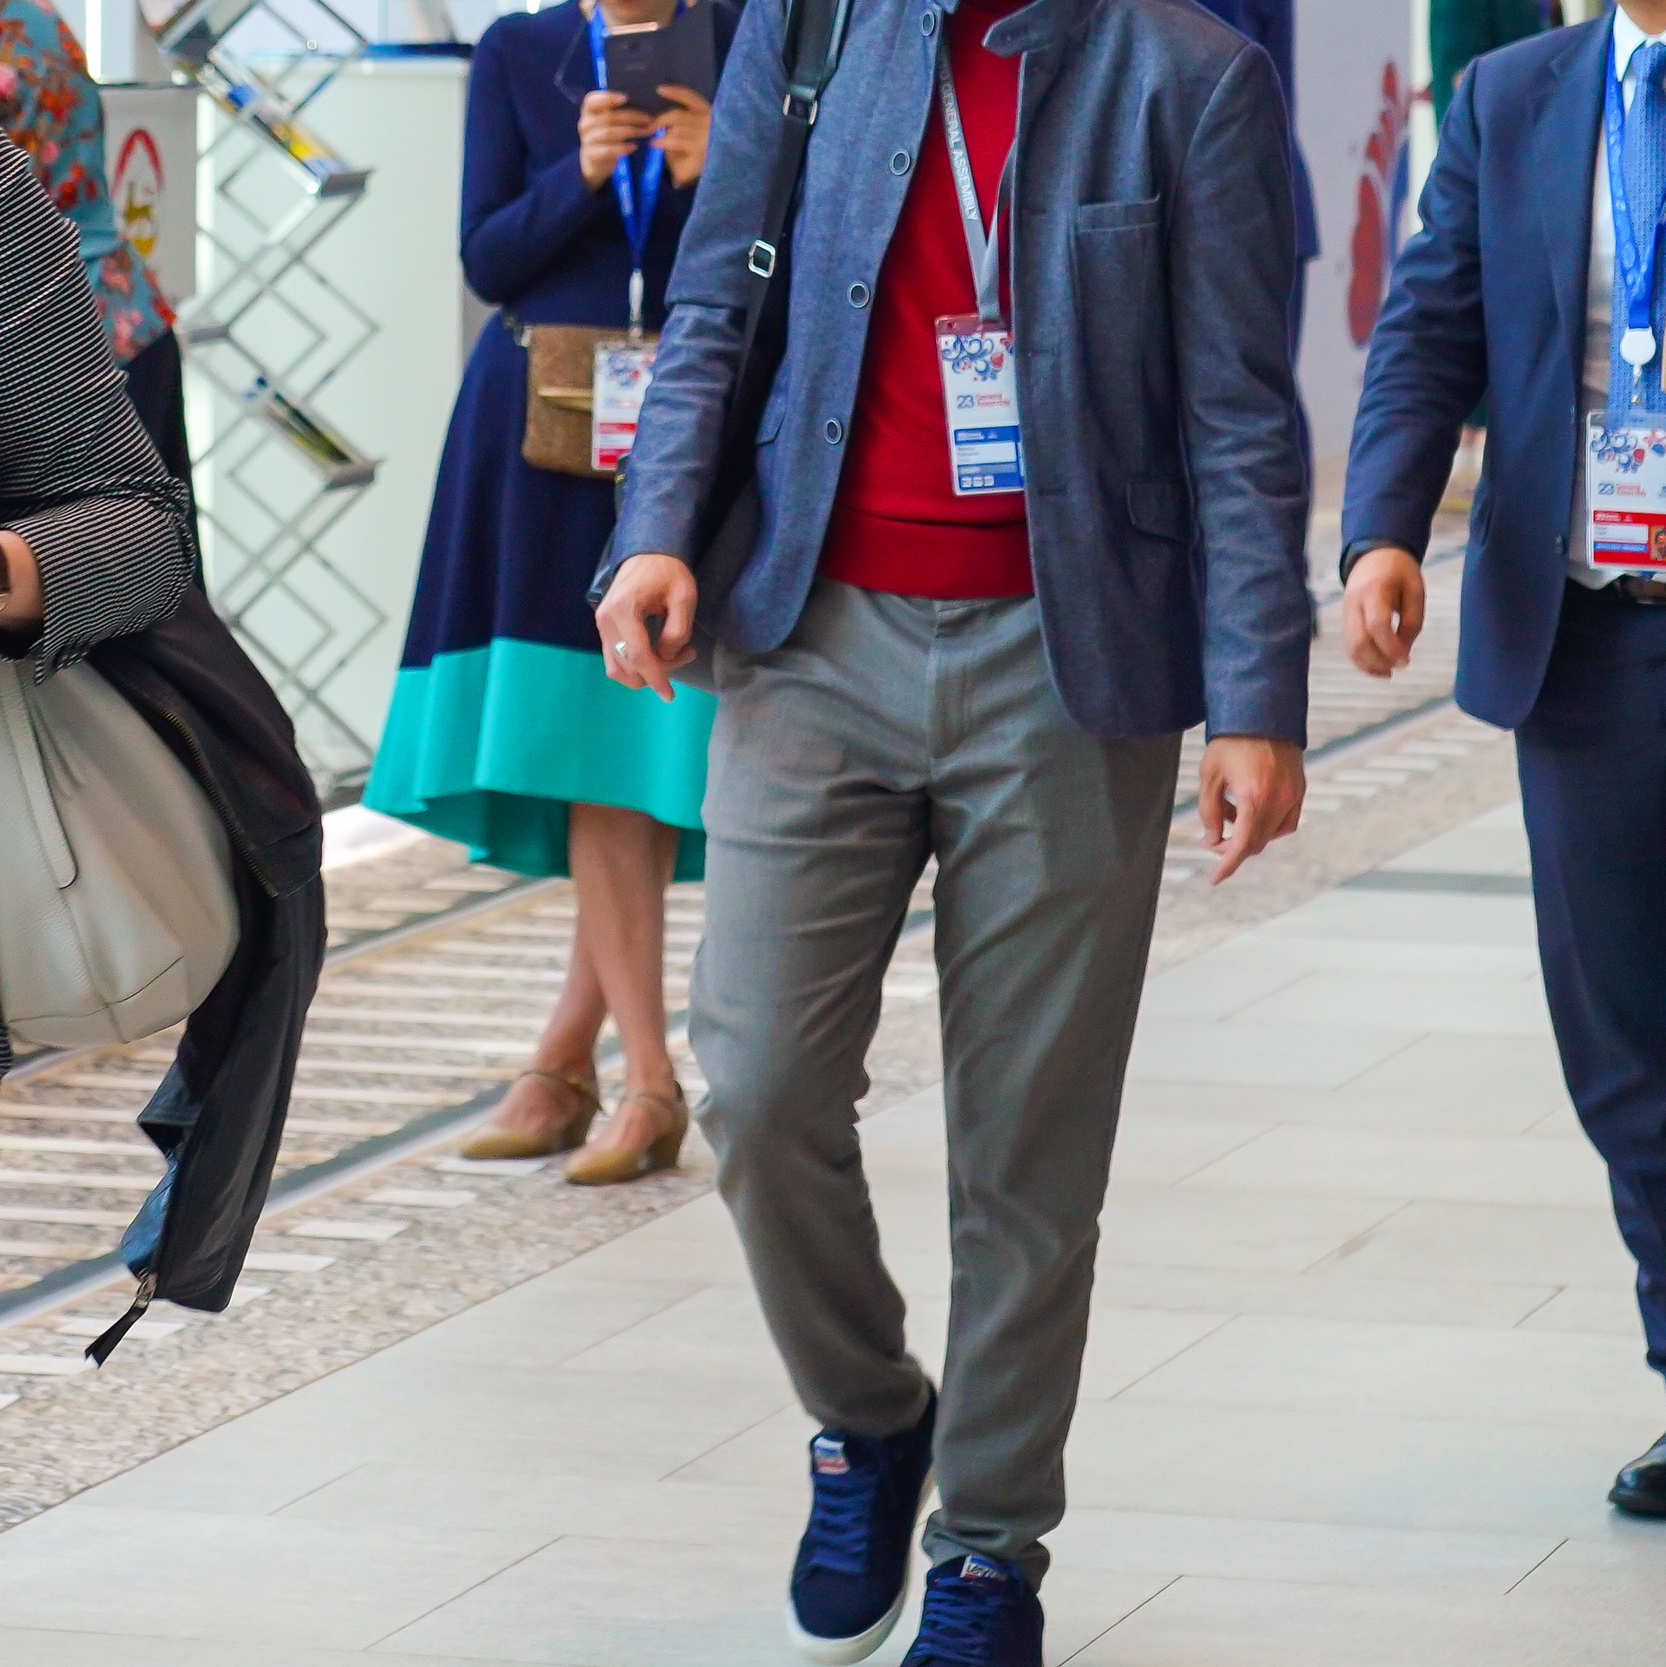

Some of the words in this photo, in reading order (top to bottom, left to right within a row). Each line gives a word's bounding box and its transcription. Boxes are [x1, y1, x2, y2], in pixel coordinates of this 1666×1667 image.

[940, 81, 961, 149] GENERAL
[951, 149, 979, 222] ASSEMBLY
[957, 394, 975, 410] 23
